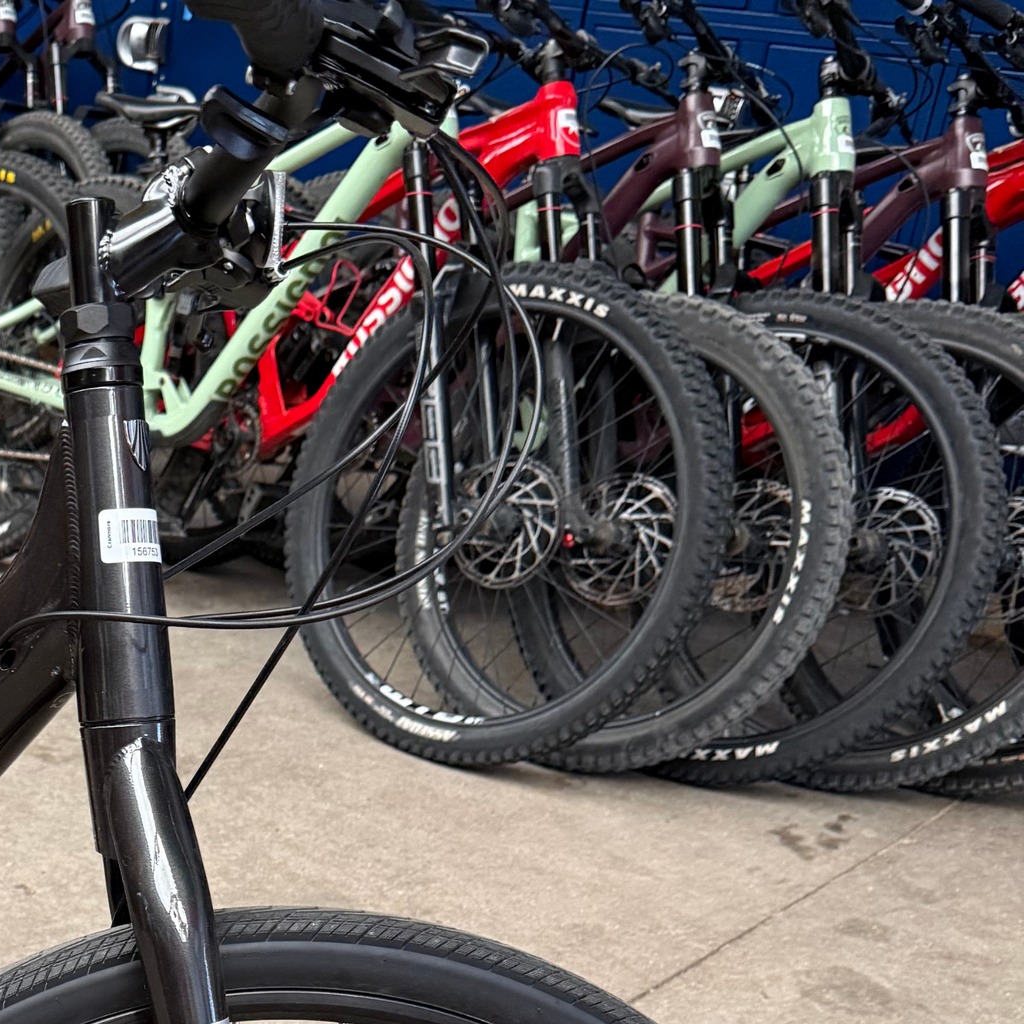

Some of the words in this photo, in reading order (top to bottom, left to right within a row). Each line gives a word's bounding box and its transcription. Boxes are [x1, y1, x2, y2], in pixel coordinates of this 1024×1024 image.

[508, 283, 611, 319] MAXXIS
[132, 546, 159, 557] 156753
[772, 499, 812, 626] MAXXIS
[888, 700, 1007, 763] MAXXIS
[689, 740, 781, 762] MAXX
